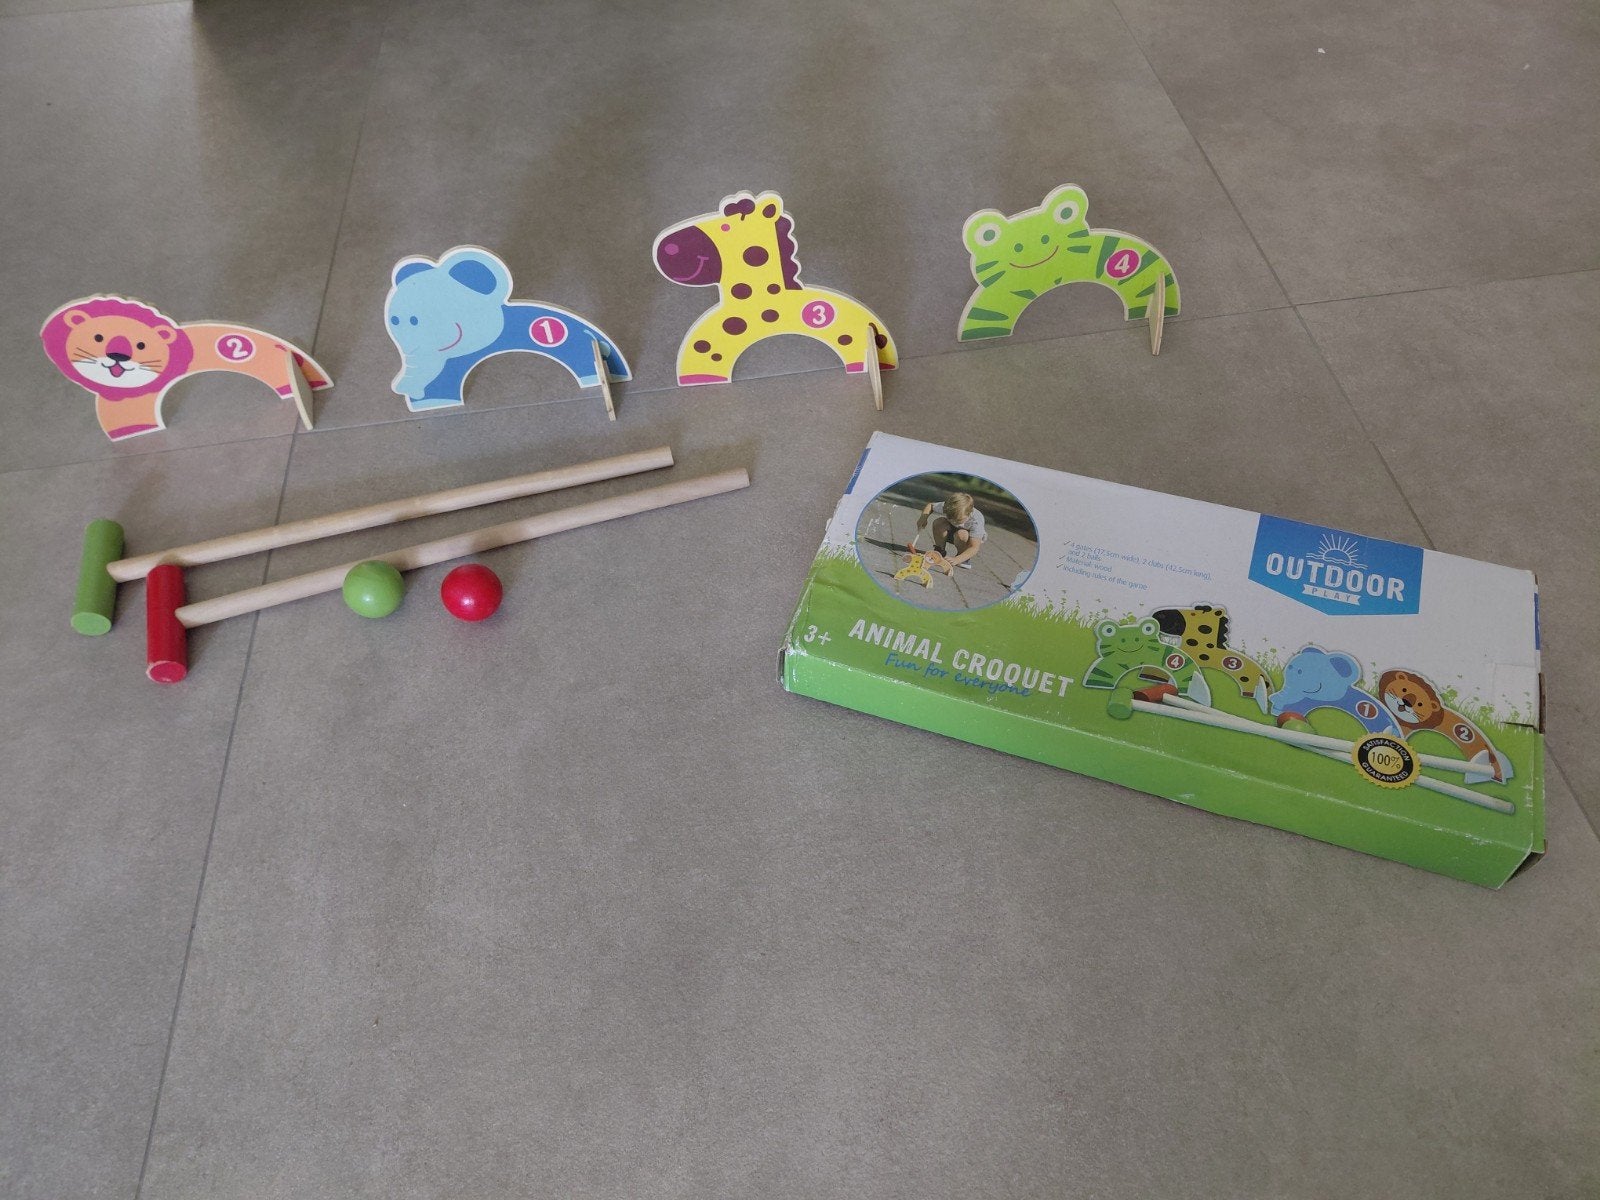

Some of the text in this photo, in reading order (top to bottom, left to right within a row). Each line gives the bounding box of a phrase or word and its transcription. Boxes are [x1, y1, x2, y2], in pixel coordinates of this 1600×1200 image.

[1114, 253, 1130, 273] 4
[812, 304, 827, 325] 3
[539, 320, 554, 343] 1
[226, 338, 248, 358] 2
[1094, 563, 1113, 573] wood
[1266, 552, 1405, 602] OUTDOOR
[1092, 573, 1107, 581] rules
[1116, 577, 1127, 586] the
[1128, 580, 1148, 591] game
[1311, 587, 1351, 602] PLAY
[803, 624, 832, 646] 3+
[848, 618, 1075, 697] ANIMAL CROQUET
[1171, 656, 1179, 668] 4
[1229, 658, 1238, 669] 3
[884, 652, 1033, 697] Fun for everyone
[1363, 703, 1371, 717] 1
[1460, 726, 1469, 741] 2
[1362, 739, 1411, 762] SATISFACTION
[1371, 751, 1401, 770] 100%
[1361, 761, 1409, 782] GUARANTEED
